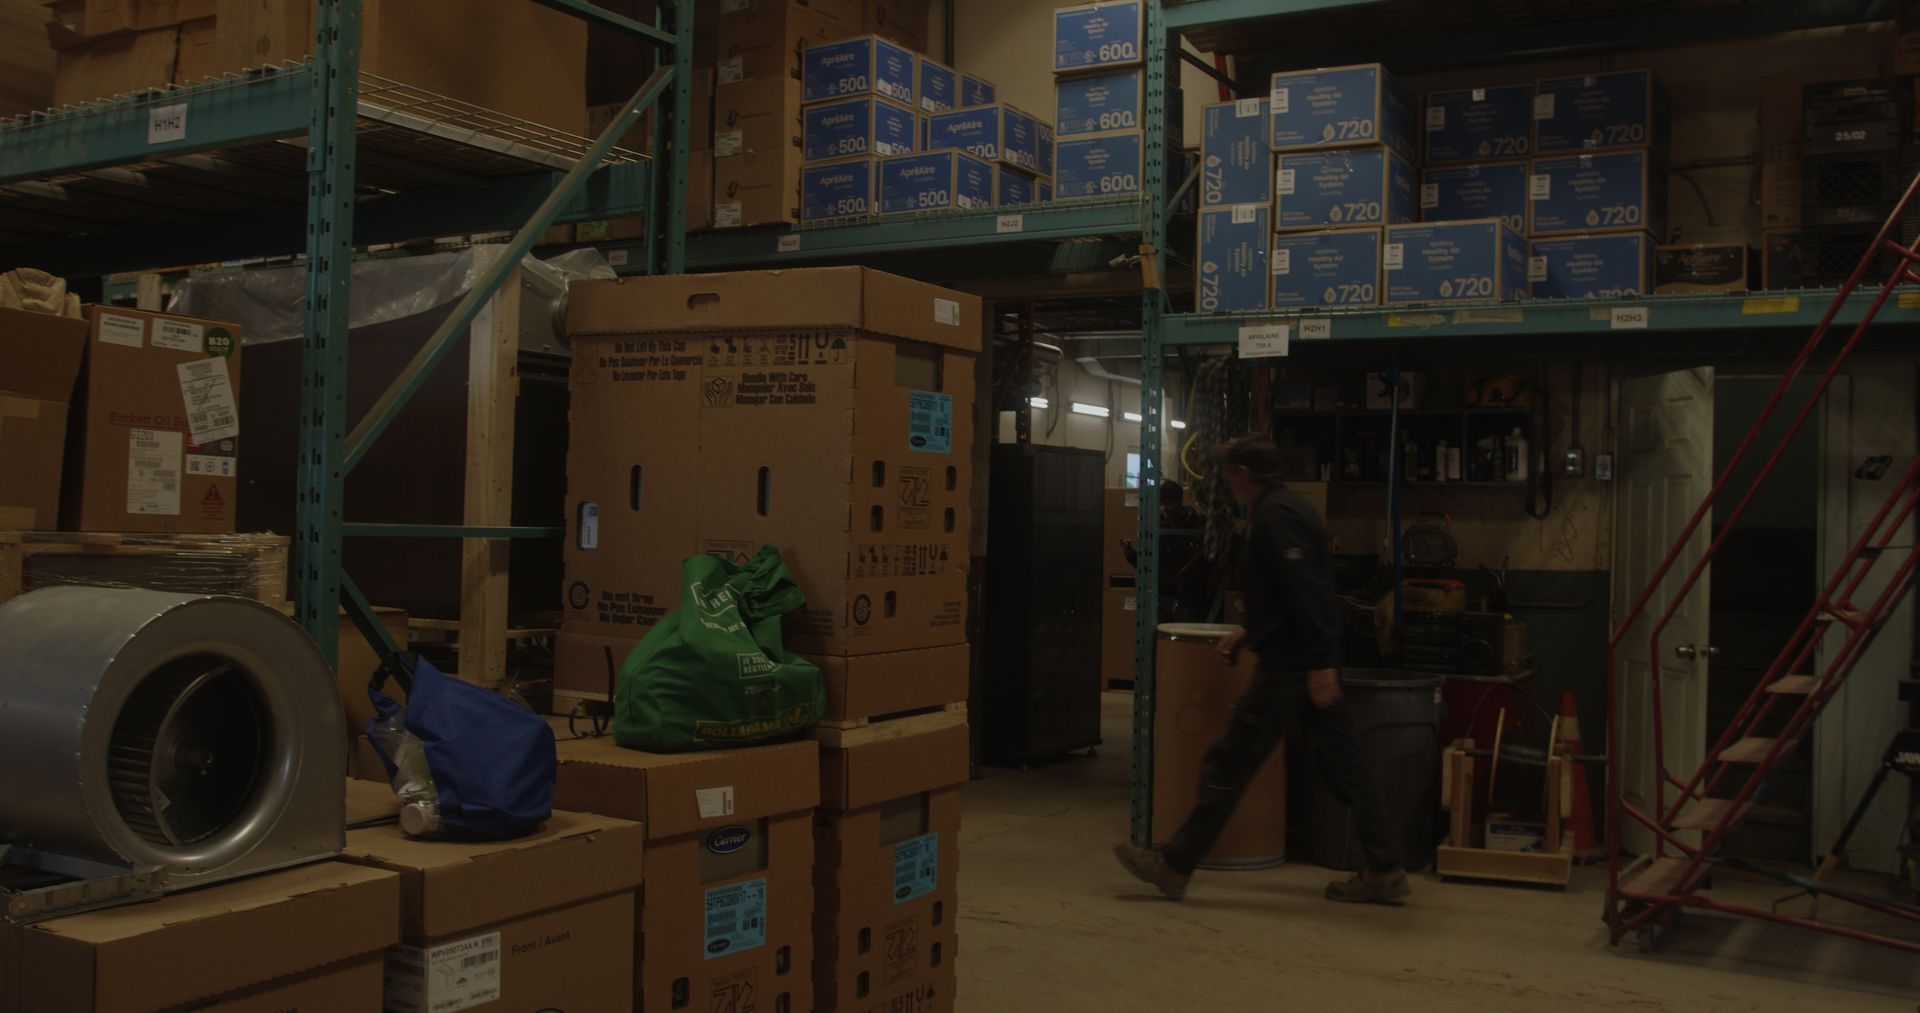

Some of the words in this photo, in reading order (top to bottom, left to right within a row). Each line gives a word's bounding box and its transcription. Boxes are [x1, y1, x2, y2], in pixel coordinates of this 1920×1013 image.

[820, 53, 856, 68] AprilAire
[1099, 42, 1133, 61] 600
[839, 75, 867, 93] 500
[154, 116, 181, 132] H1H2
[820, 113, 856, 128] AprilAire
[946, 119, 983, 134] AprilAire
[1100, 110, 1133, 129] 600
[1337, 119, 1373, 139] 720
[1605, 123, 1643, 144] 720
[839, 136, 867, 154] 500
[1491, 136, 1529, 155] 720
[820, 173, 854, 187] AprilAire
[900, 165, 936, 180] AprilAire
[1100, 174, 1135, 193] 600
[1205, 168, 1223, 204] 720
[838, 197, 865, 215] 500
[919, 190, 947, 208] 500
[1344, 202, 1380, 221] 720
[1600, 204, 1640, 225] 720
[1202, 274, 1219, 310] 720
[1338, 283, 1374, 303] 720
[1455, 276, 1493, 296] 720
[1616, 313, 1642, 323] H2H3
[1304, 324, 1326, 333] H2H1
[208, 336, 230, 346] B20
[110, 411, 152, 423] Beckett
[154, 415, 170, 426] Oil
[713, 833, 747, 847] Carrier
[511, 942, 537, 956] Front
[544, 931, 571, 946] Avant
